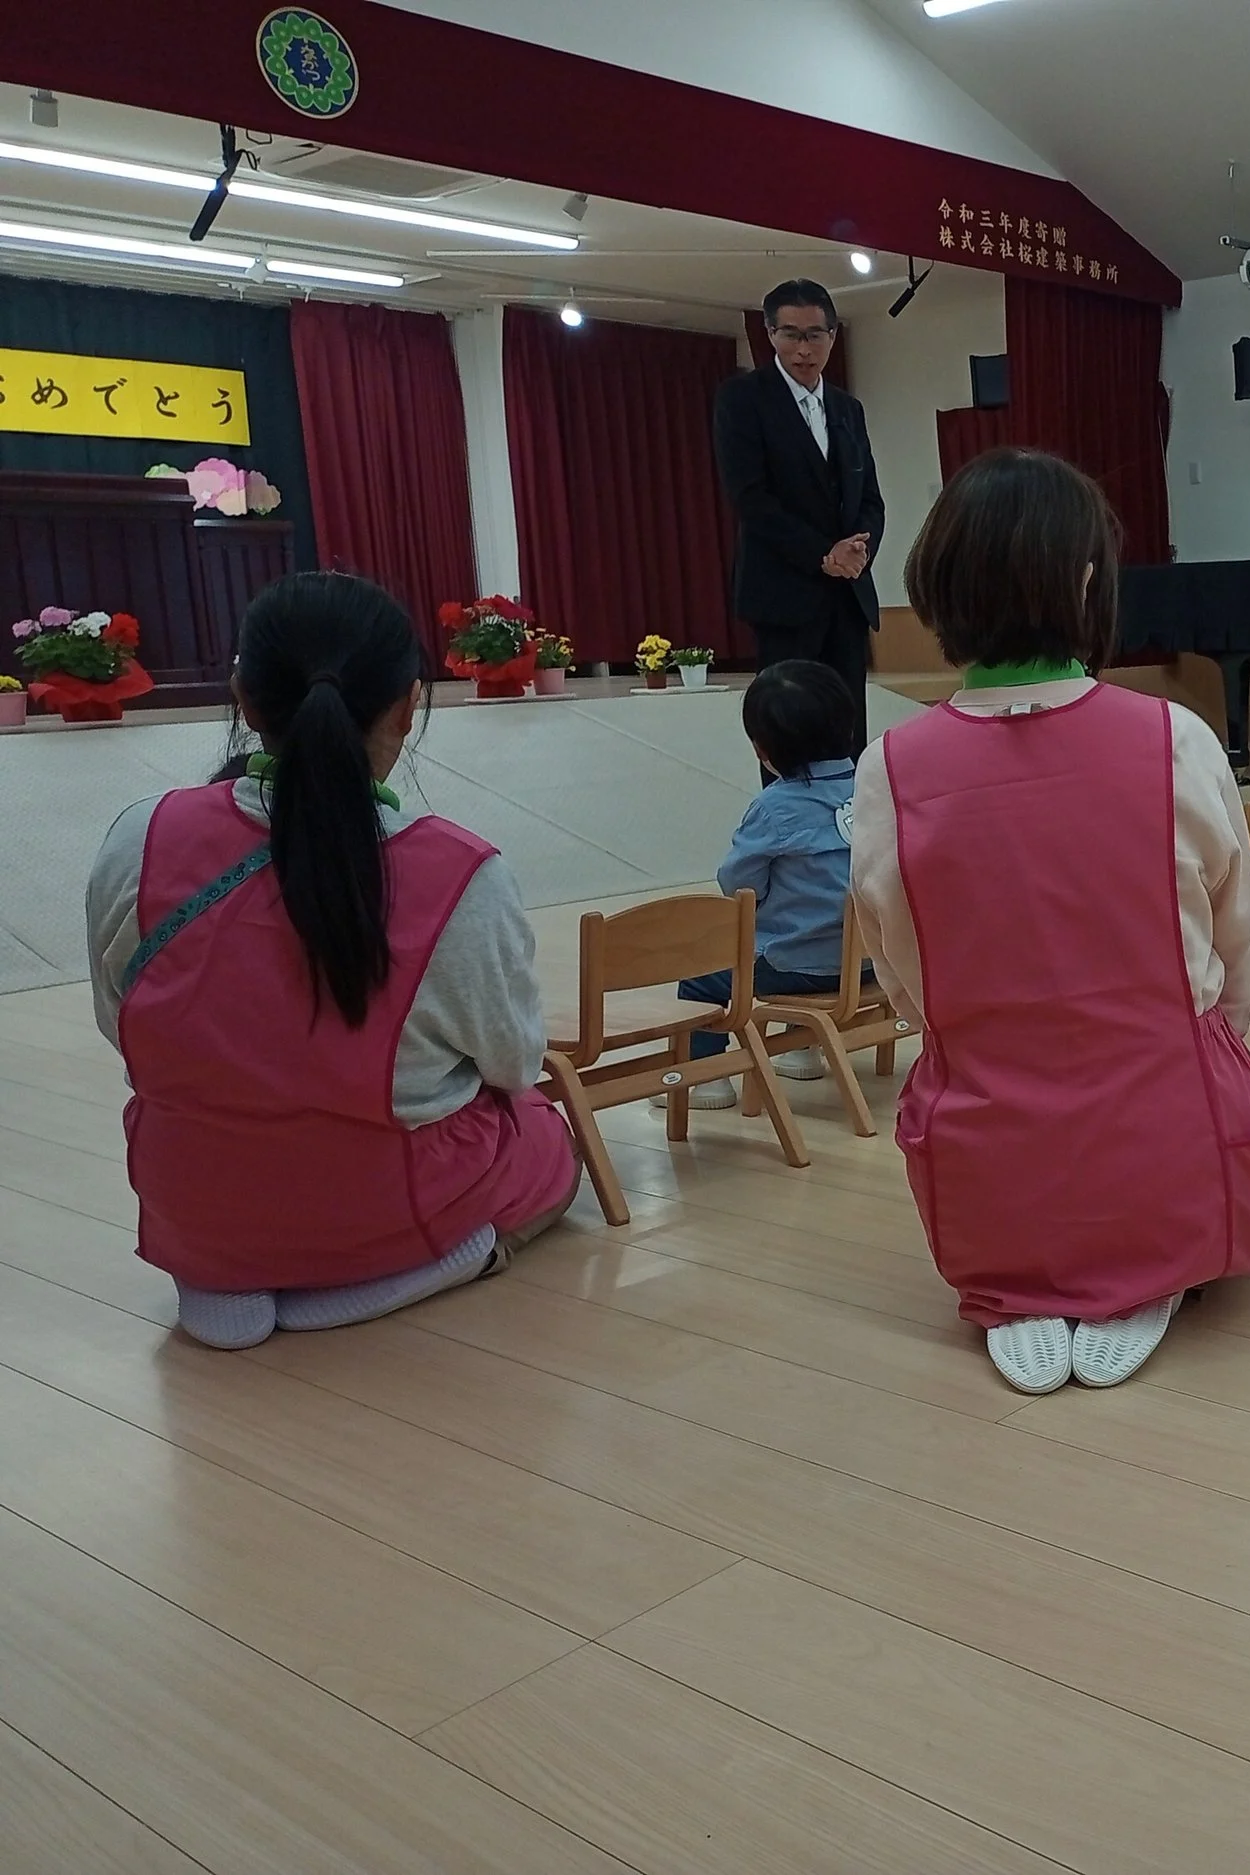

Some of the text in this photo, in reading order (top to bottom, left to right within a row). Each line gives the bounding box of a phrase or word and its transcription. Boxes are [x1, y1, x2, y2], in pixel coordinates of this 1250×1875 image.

[937, 198, 1067, 248] 令和三年度寄贈
[938, 225, 1120, 285] 株式会社桜建築事務所
